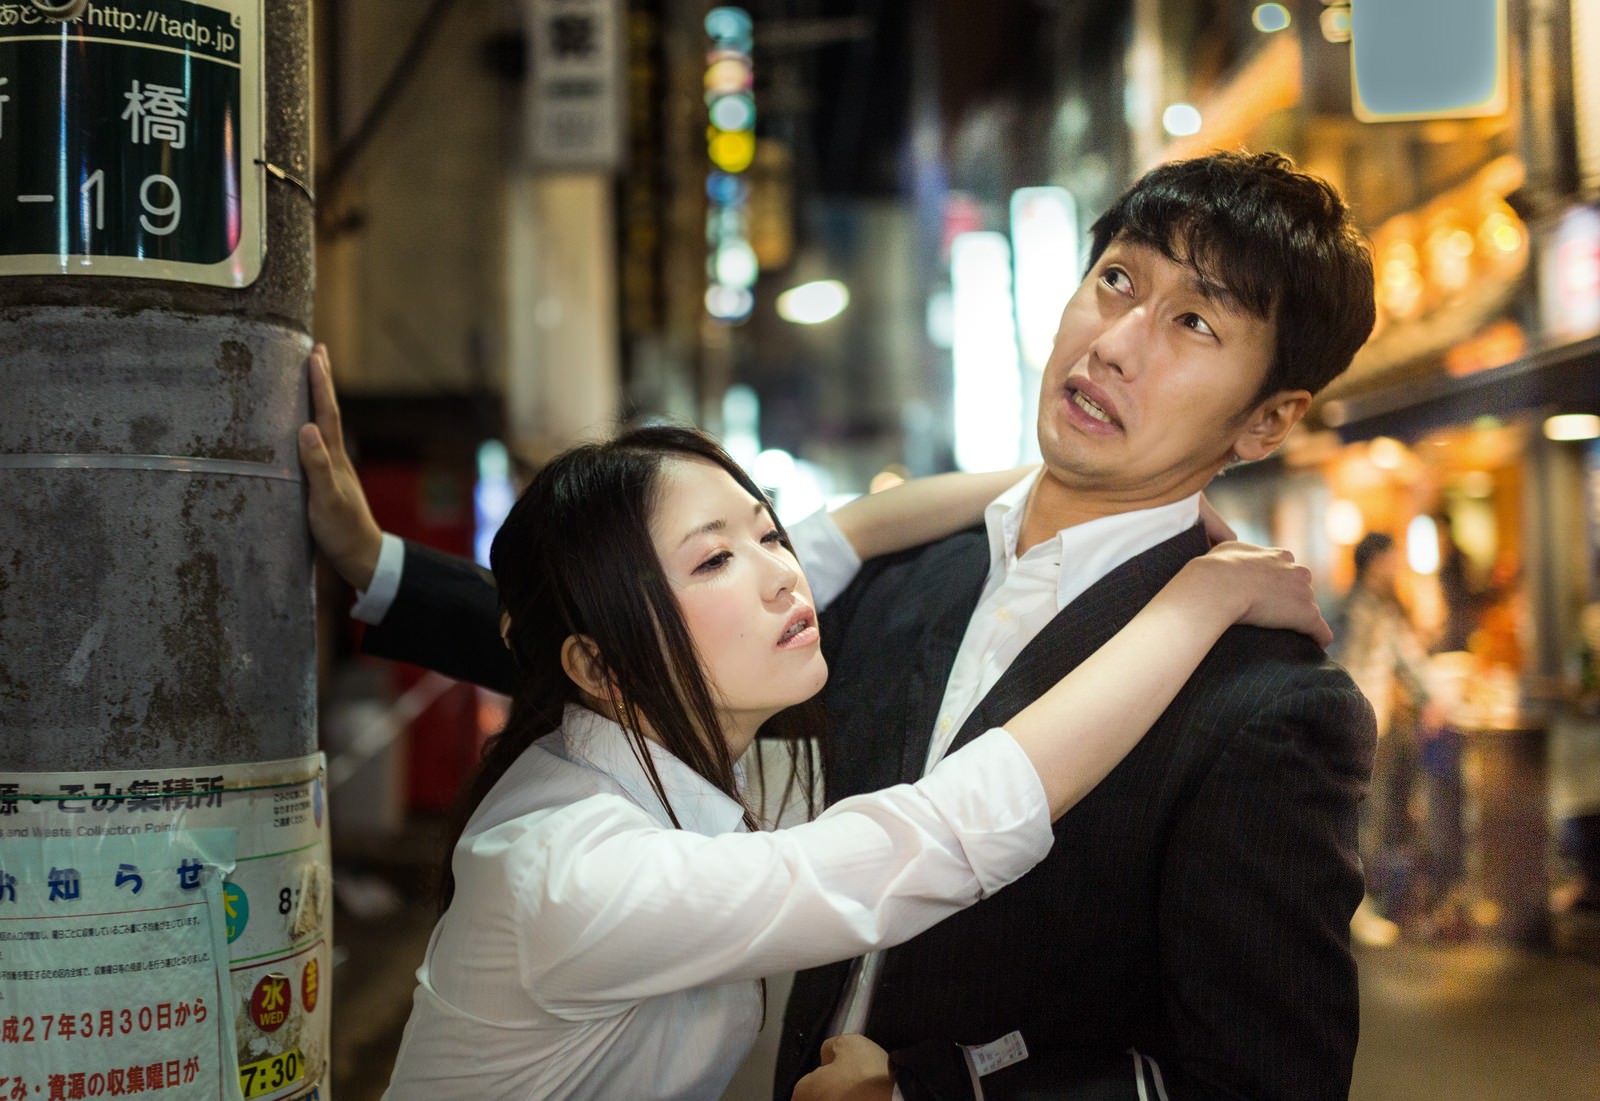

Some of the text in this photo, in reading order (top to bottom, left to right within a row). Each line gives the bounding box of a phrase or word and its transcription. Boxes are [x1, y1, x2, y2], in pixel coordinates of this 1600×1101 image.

[88, 5, 235, 51] http://tadp.jp
[76, 824, 142, 837] Collection
[261, 977, 285, 1011] 水
[259, 1010, 285, 1026] WED
[240, 1053, 297, 1097] 7:30
